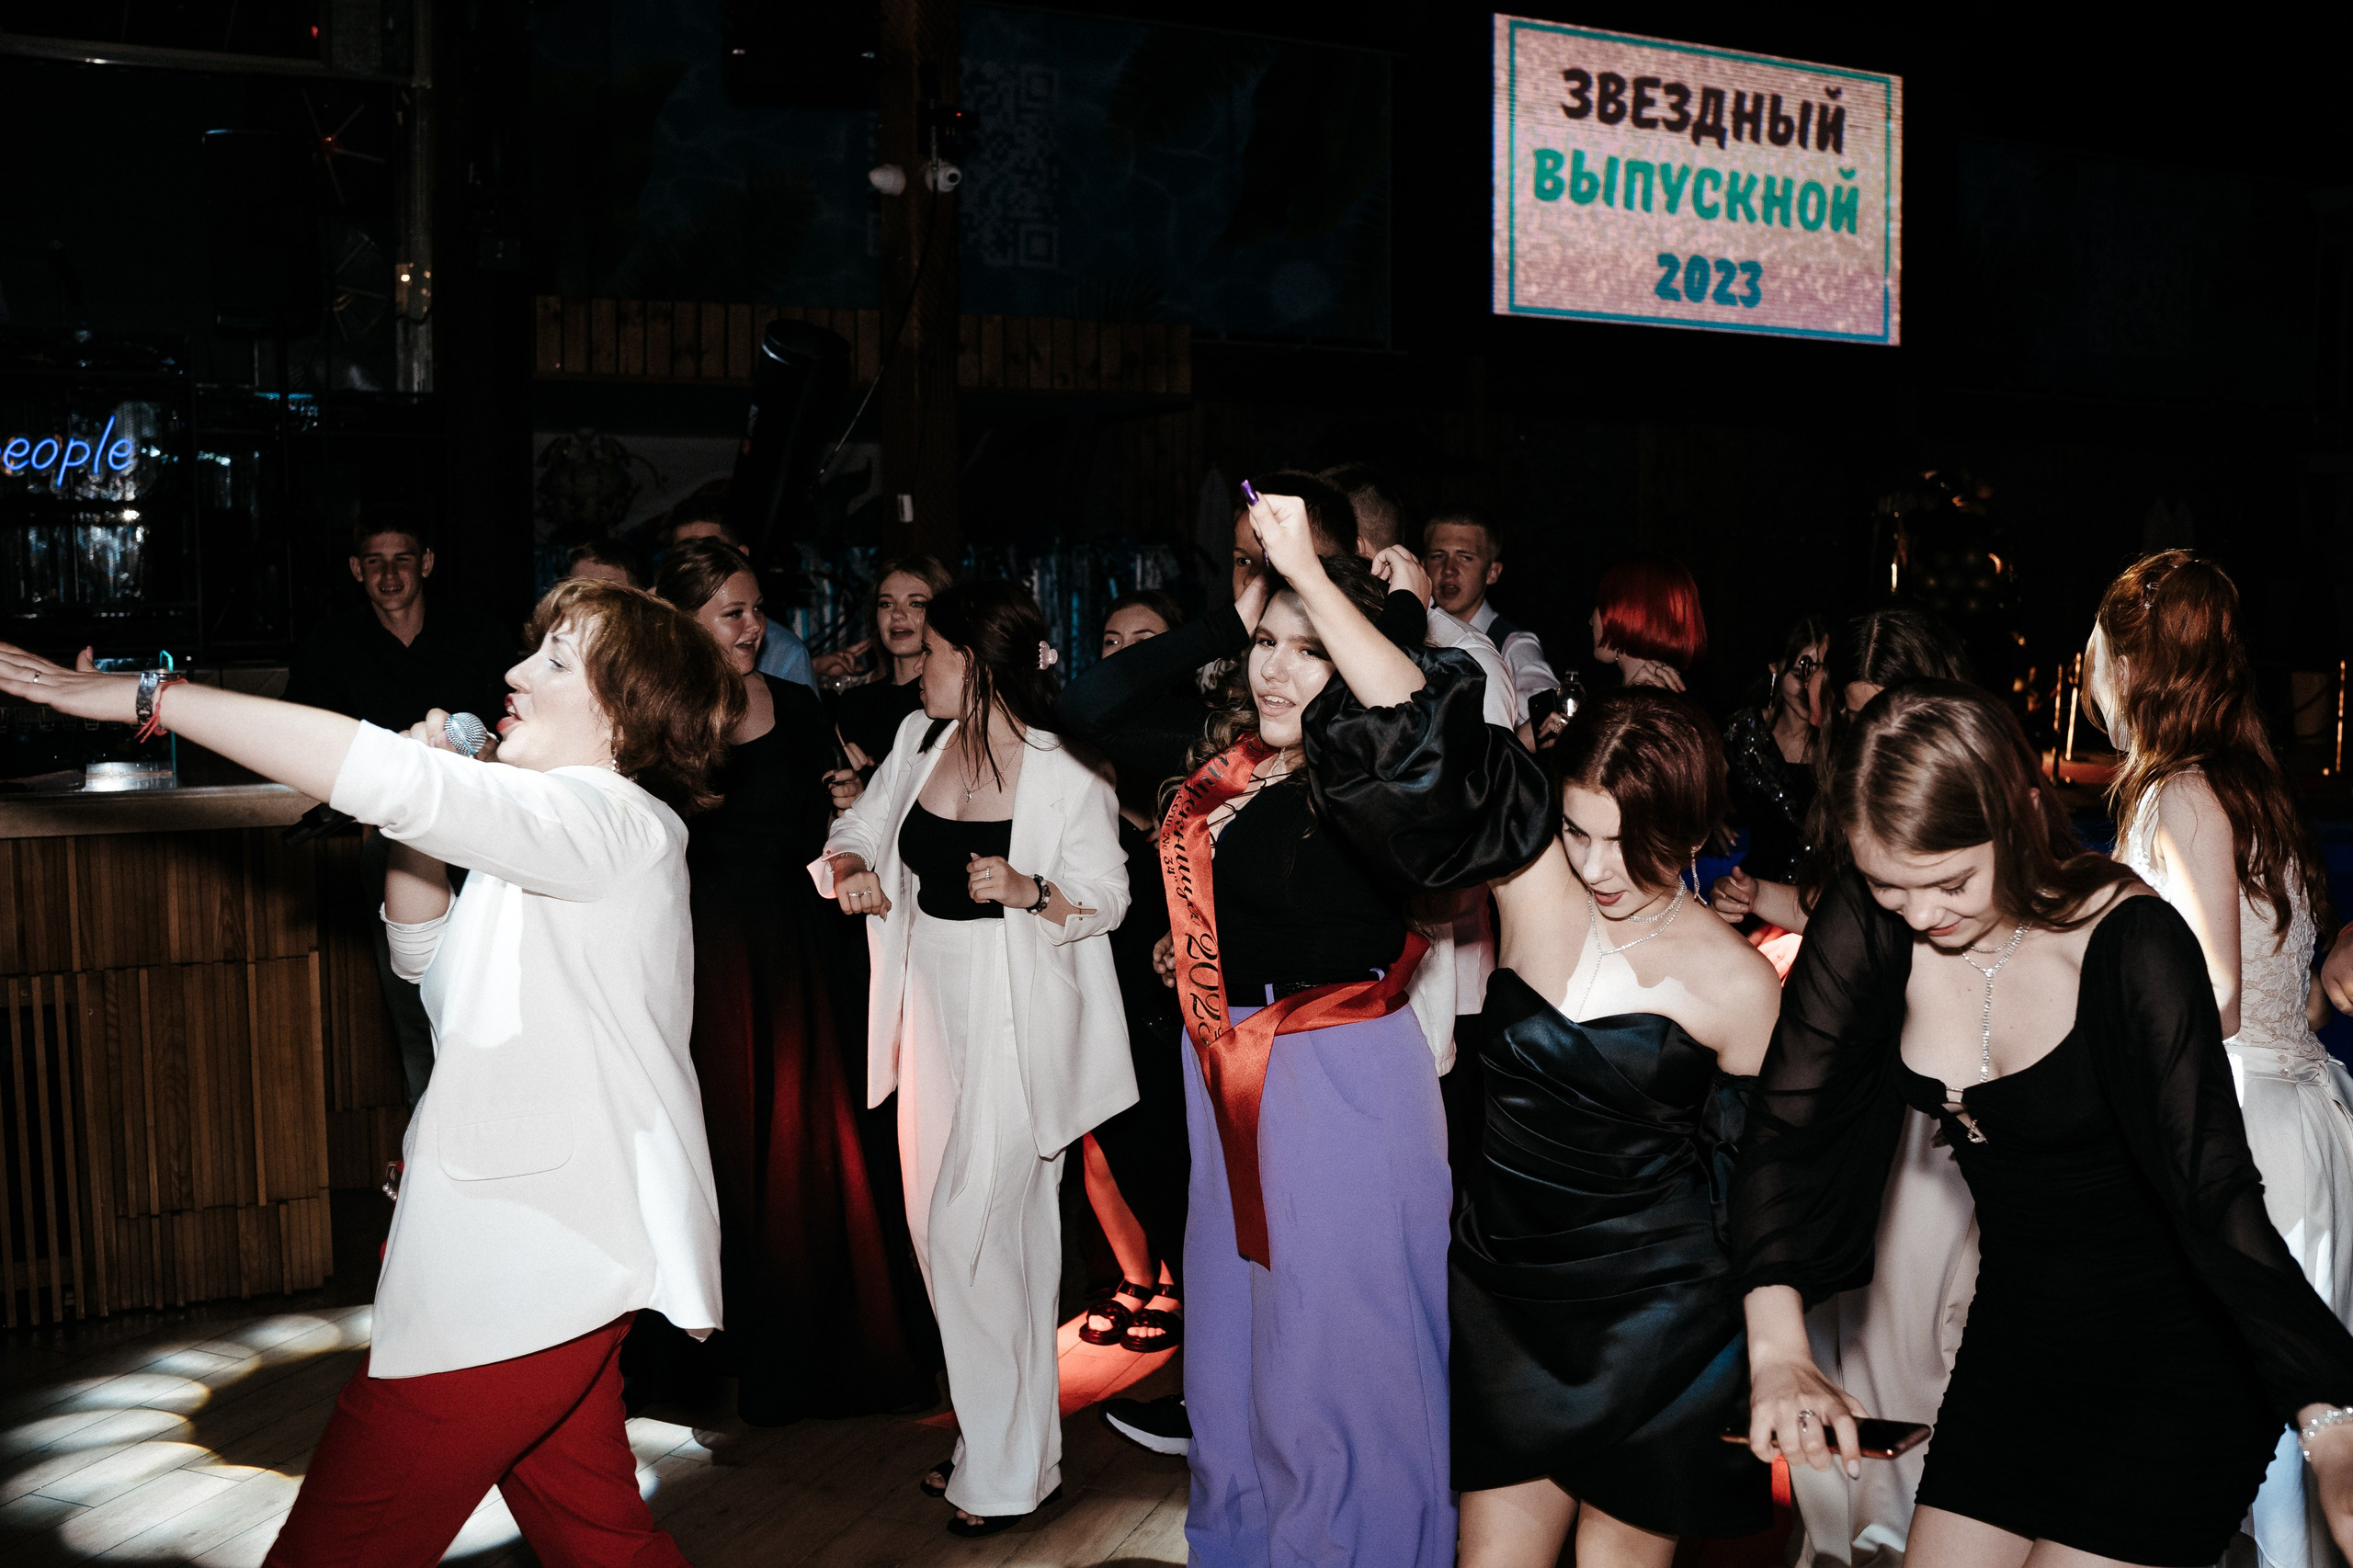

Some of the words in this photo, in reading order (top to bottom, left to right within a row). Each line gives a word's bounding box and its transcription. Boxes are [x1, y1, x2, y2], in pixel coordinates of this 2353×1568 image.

[1561, 68, 1846, 153] ЗВЕЗДНЫЙ
[1533, 148, 1859, 234] ВЫПУСКНОЙ
[1654, 253, 1764, 308] 2023
[0, 415, 134, 488] eople
